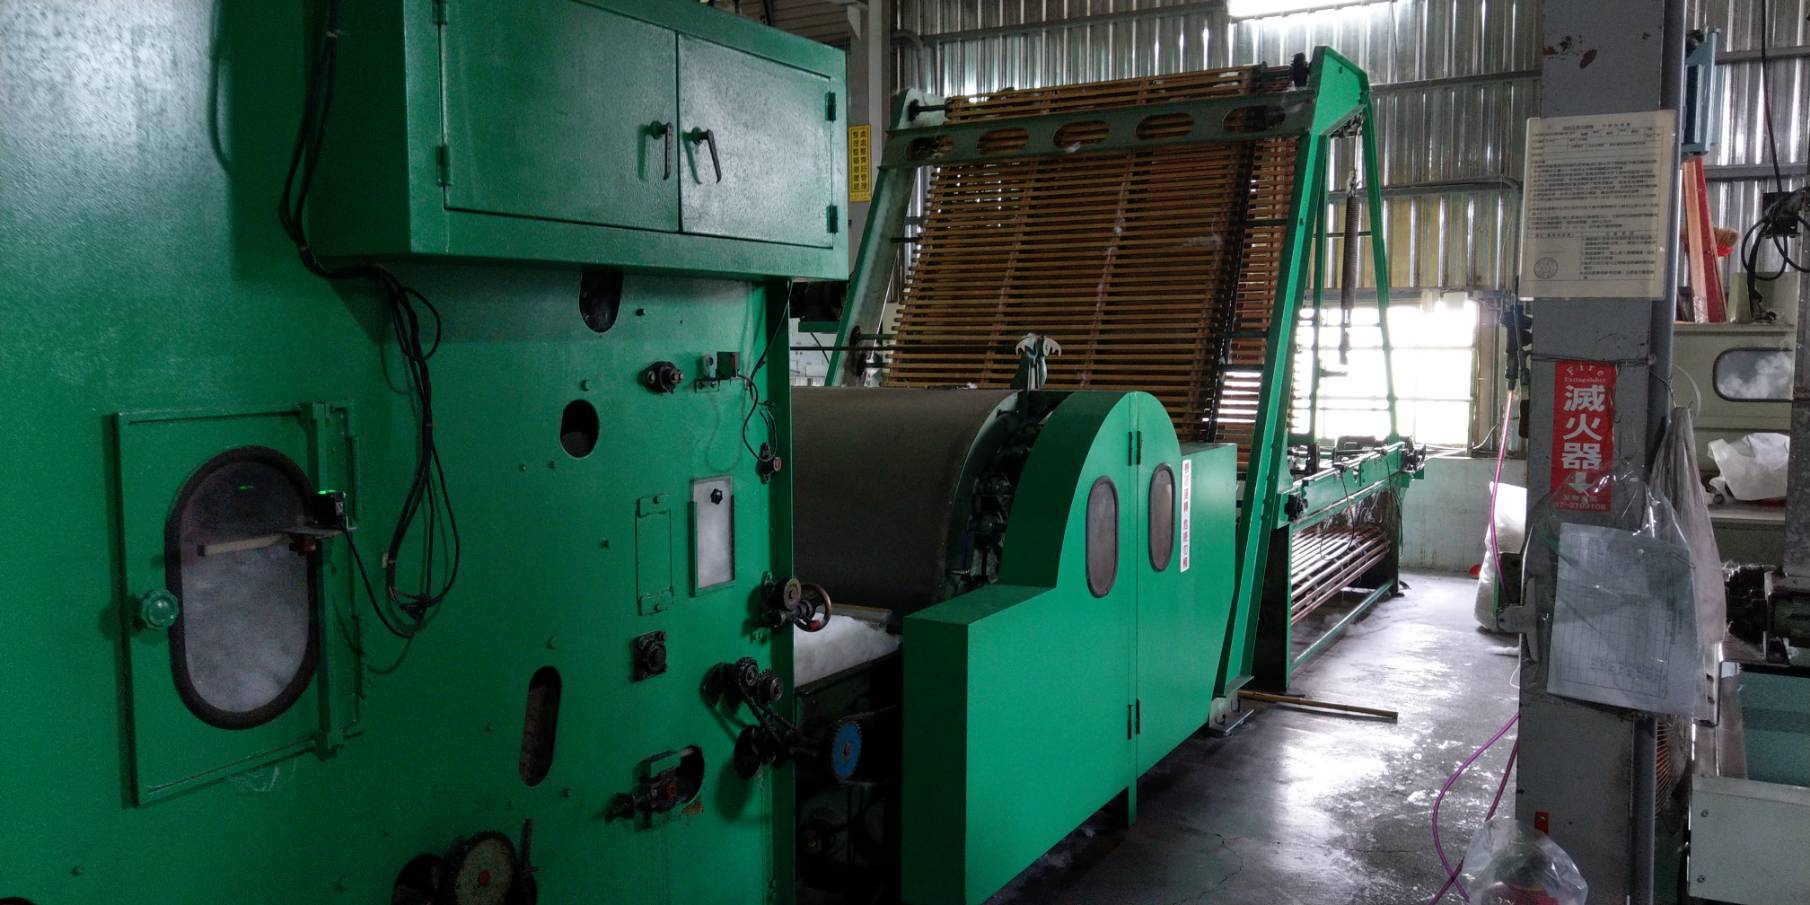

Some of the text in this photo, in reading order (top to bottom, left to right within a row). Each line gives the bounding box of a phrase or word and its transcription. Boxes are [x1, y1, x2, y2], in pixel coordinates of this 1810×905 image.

[1566, 364, 1605, 376] Fire
[1561, 384, 1606, 471] 滅火器
